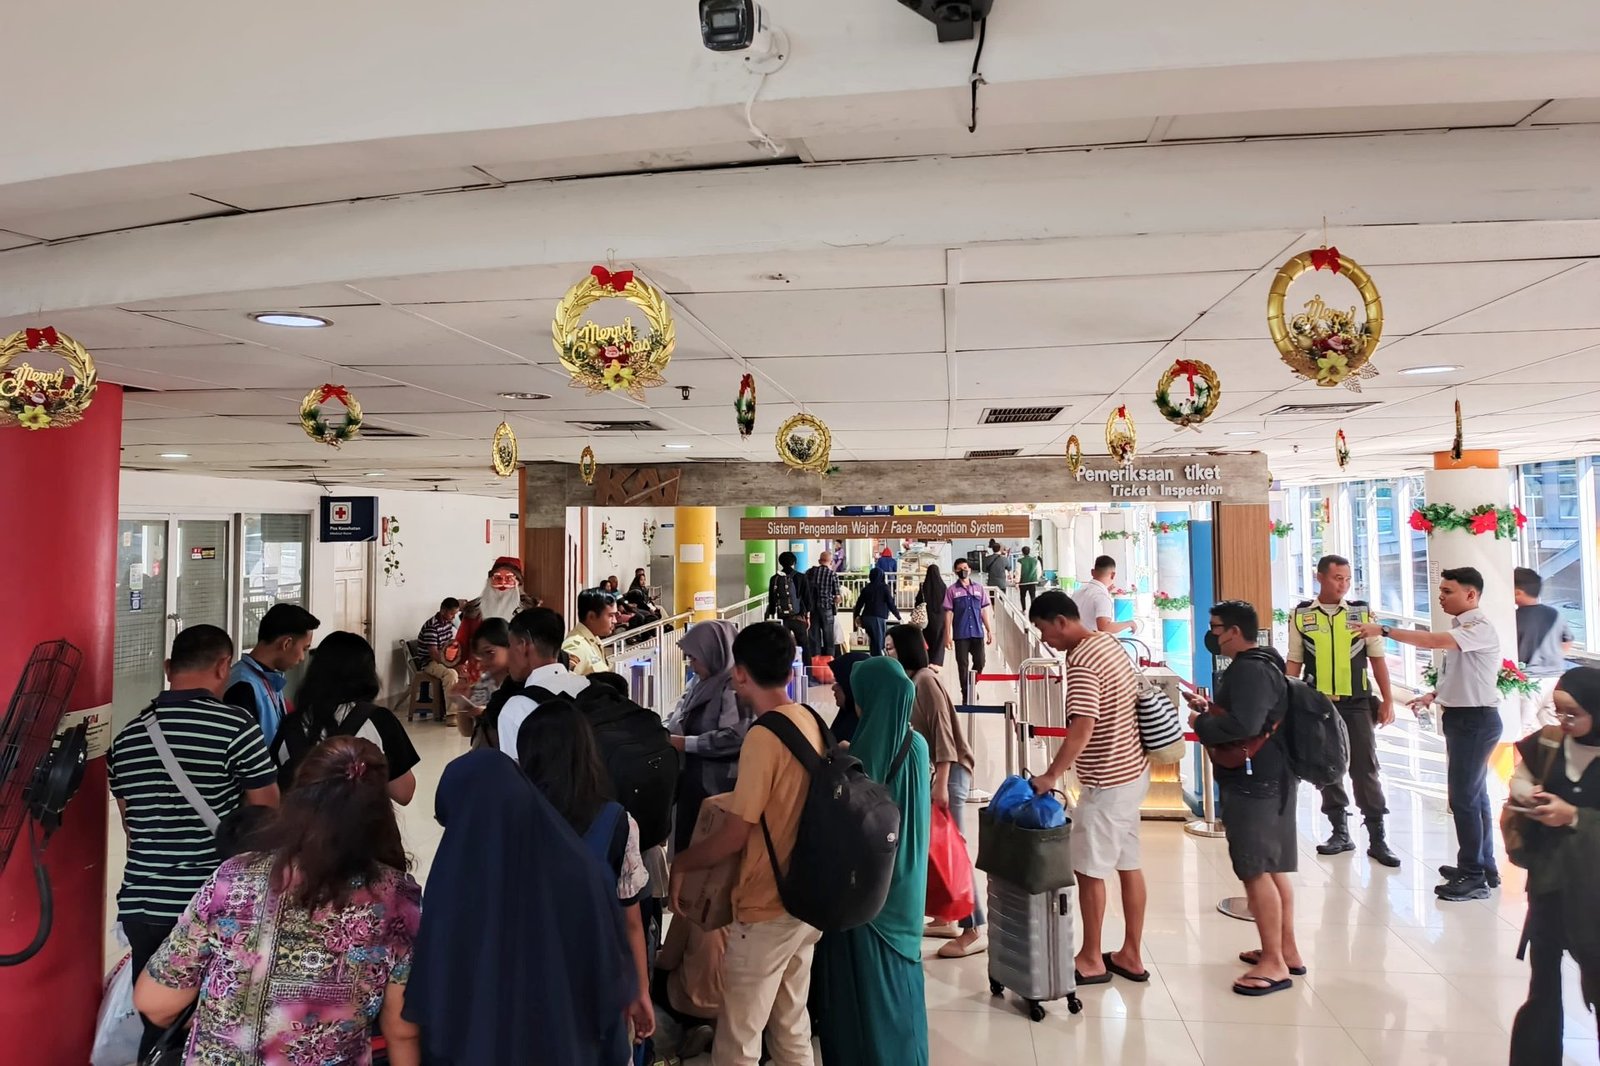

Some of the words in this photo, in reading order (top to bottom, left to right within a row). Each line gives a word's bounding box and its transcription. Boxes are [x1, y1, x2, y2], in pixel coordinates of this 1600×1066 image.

[578, 317, 632, 346] Merry
[11, 362, 64, 390] Merry
[1076, 465, 1174, 483] Pemeriksaan
[1184, 463, 1221, 481] tiket
[1110, 484, 1152, 497] Ticket
[1160, 483, 1223, 499] Inspection
[767, 521, 797, 535] Sistem
[799, 521, 848, 537] Pengenalan
[851, 521, 880, 537] Wajah
[881, 521, 888, 534] /
[890, 520, 912, 534] Face
[915, 520, 967, 536] Recognition
[970, 521, 1004, 536] System
